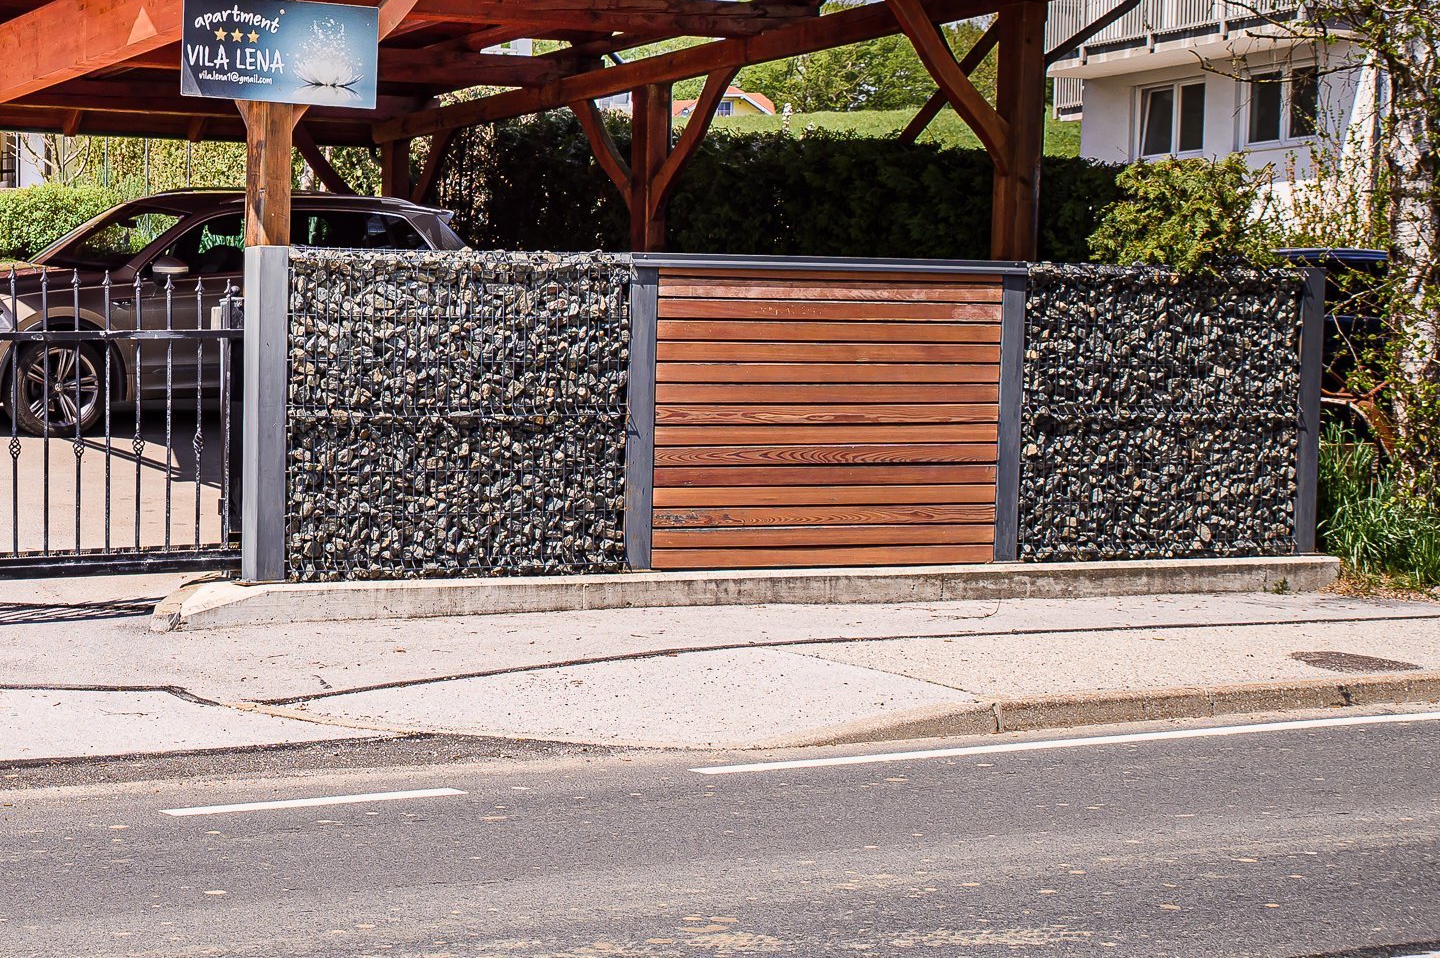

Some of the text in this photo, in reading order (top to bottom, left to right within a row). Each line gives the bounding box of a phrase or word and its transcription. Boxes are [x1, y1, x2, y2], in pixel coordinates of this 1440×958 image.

[195, 5, 279, 33] apartment
[187, 44, 285, 74] VILA LENA
